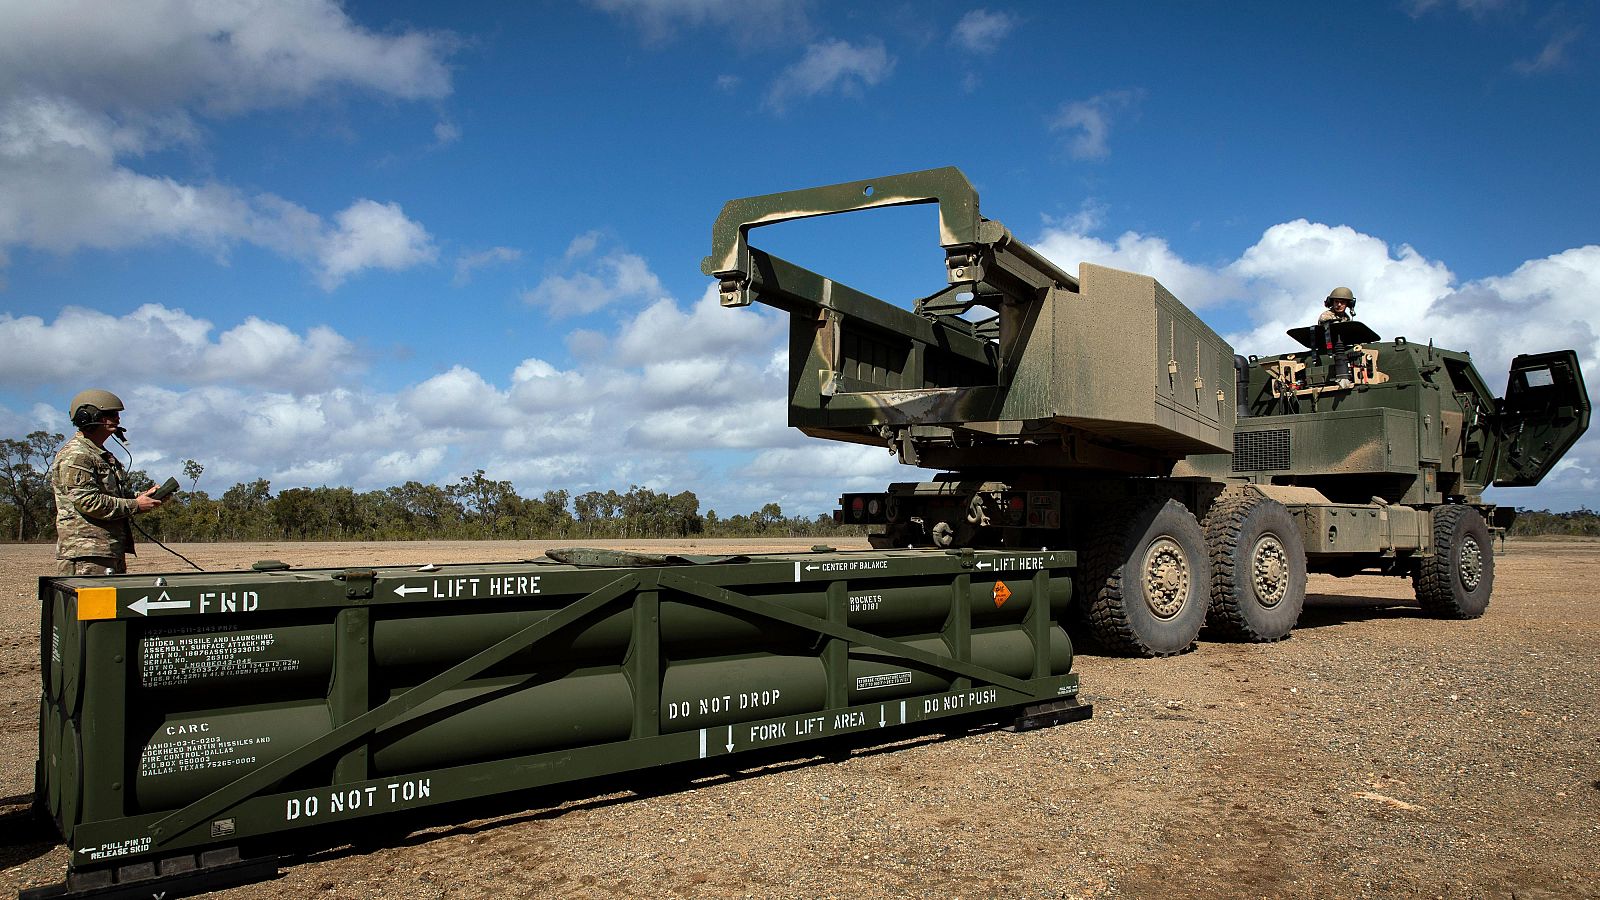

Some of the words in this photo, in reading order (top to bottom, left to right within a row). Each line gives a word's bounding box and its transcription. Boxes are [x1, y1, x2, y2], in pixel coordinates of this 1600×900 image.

[822, 562, 848, 571] CENTER
[860, 561, 888, 570] BALANCE
[993, 558, 1015, 572] LIFT
[1019, 557, 1044, 570] HERE
[433, 578, 480, 599] LIFT
[490, 576, 541, 596] HERE
[199, 591, 259, 614] FWD
[850, 596, 882, 604] ROCKETS
[669, 701, 690, 719] DO
[699, 695, 731, 715] NOT
[739, 689, 780, 709] DROP
[924, 698, 939, 714] DO
[943, 694, 965, 710] NOT
[969, 689, 996, 706] PUSH
[166, 723, 209, 735] CARC
[750, 722, 786, 742] FORK
[795, 717, 825, 735] LIFT
[833, 711, 865, 730] AREA
[142, 746, 184, 757] LOCKHEED
[188, 743, 216, 752] MARTIN
[218, 739, 253, 748] MISSILES
[164, 747, 234, 761] CONTROL-DALLAS
[180, 757, 210, 765] 650003
[180, 763, 204, 772] TEXAS
[207, 756, 256, 768] 75265-0003
[286, 796, 318, 821] DO
[330, 786, 377, 813] NOT
[387, 778, 430, 803] TOW
[90, 847, 128, 860] RELEASE
[130, 844, 149, 853] SKID
[102, 842, 122, 850] PULL
[124, 839, 138, 847] PIN
